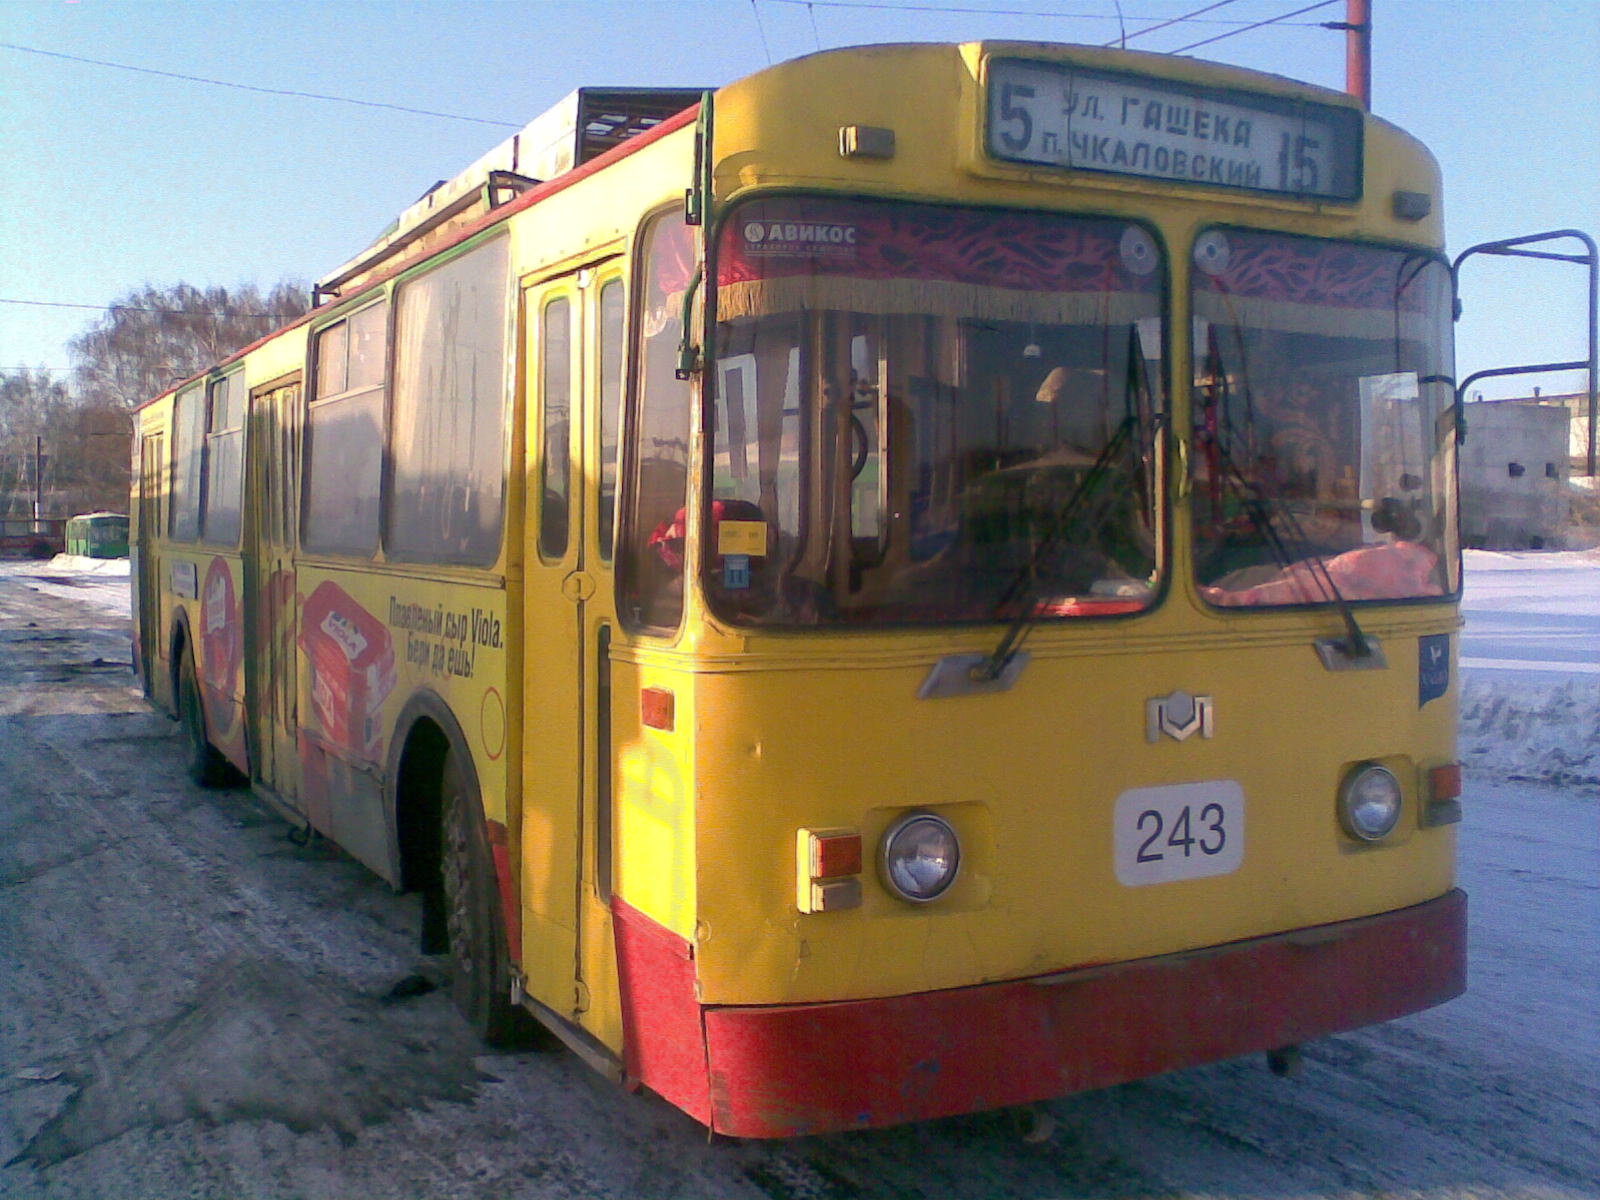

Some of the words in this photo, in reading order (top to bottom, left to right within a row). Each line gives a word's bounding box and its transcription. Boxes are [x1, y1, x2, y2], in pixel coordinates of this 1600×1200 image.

[1001, 82, 1035, 152] 5
[1120, 96, 1254, 149] ГАШЕКА
[1071, 131, 1263, 189] ЧКАЛОВСКИЙ
[1276, 130, 1321, 193] 15
[768, 224, 856, 243] АВИКОС
[446, 610, 469, 648] сыр
[471, 607, 504, 650] Viola.
[1137, 803, 1226, 863] 243
